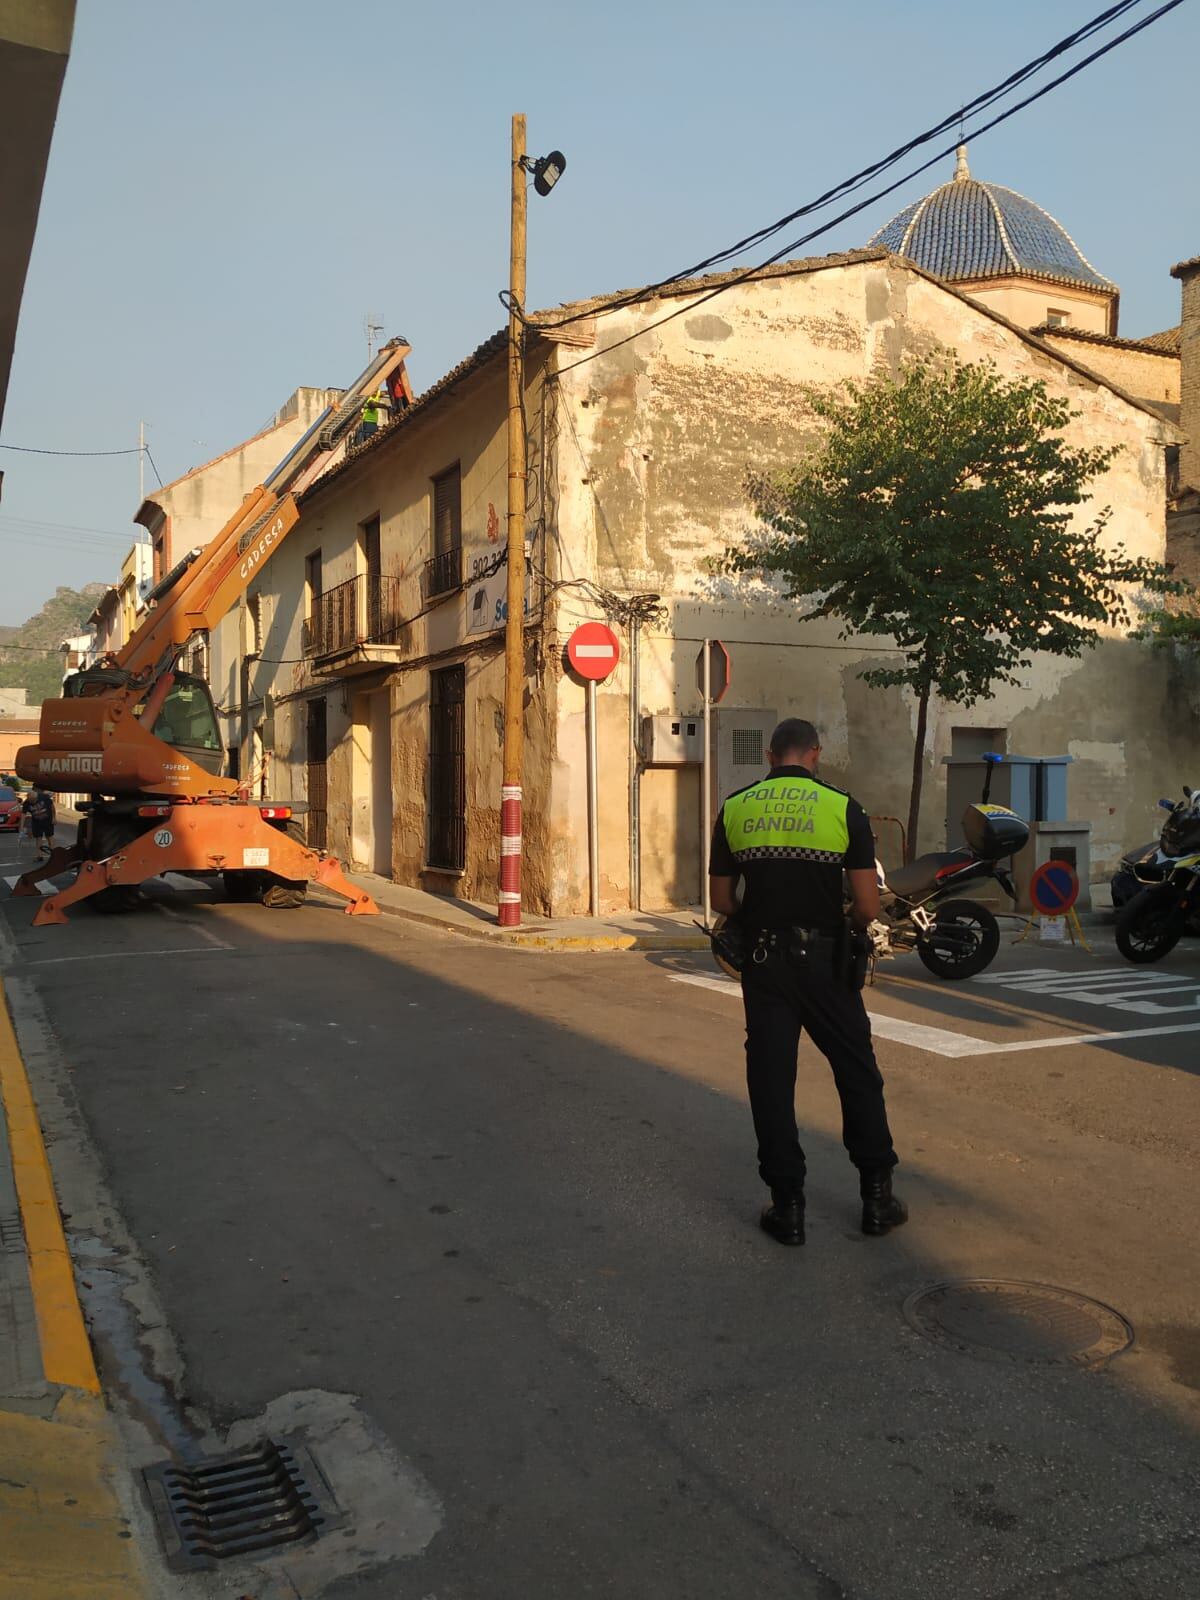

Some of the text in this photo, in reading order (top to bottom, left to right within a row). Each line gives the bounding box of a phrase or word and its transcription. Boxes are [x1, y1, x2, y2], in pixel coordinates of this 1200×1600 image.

[39, 753, 103, 772] MANITOU
[743, 787, 818, 803] POLICIA
[765, 803, 816, 816] LOCAL
[743, 817, 815, 833] GANDIA
[158, 832, 169, 845] 20
